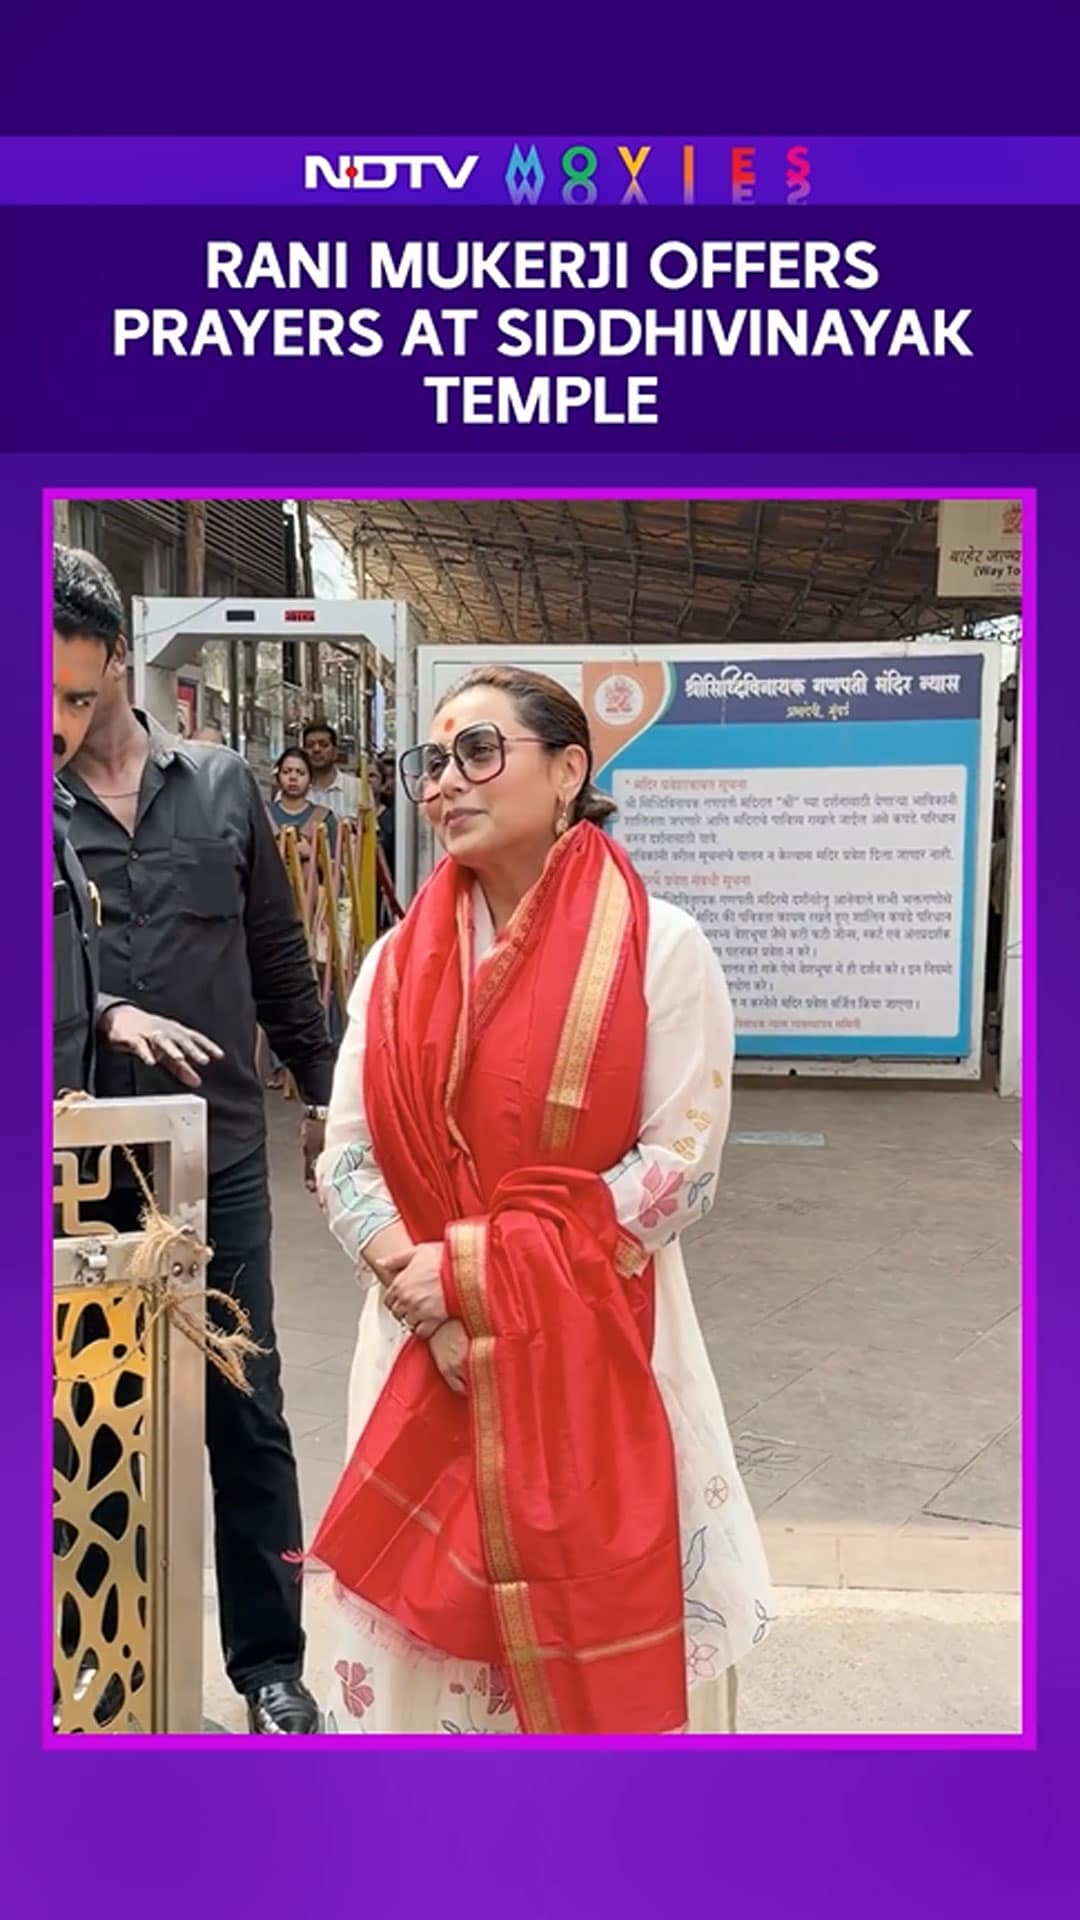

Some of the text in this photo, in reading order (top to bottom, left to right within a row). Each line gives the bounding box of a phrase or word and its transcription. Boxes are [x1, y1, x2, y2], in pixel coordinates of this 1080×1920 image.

[974, 566, 1004, 578] (Way
[813, 671, 869, 697] गणपती
[875, 672, 912, 696] मंदिर
[920, 673, 961, 695] न्यास
